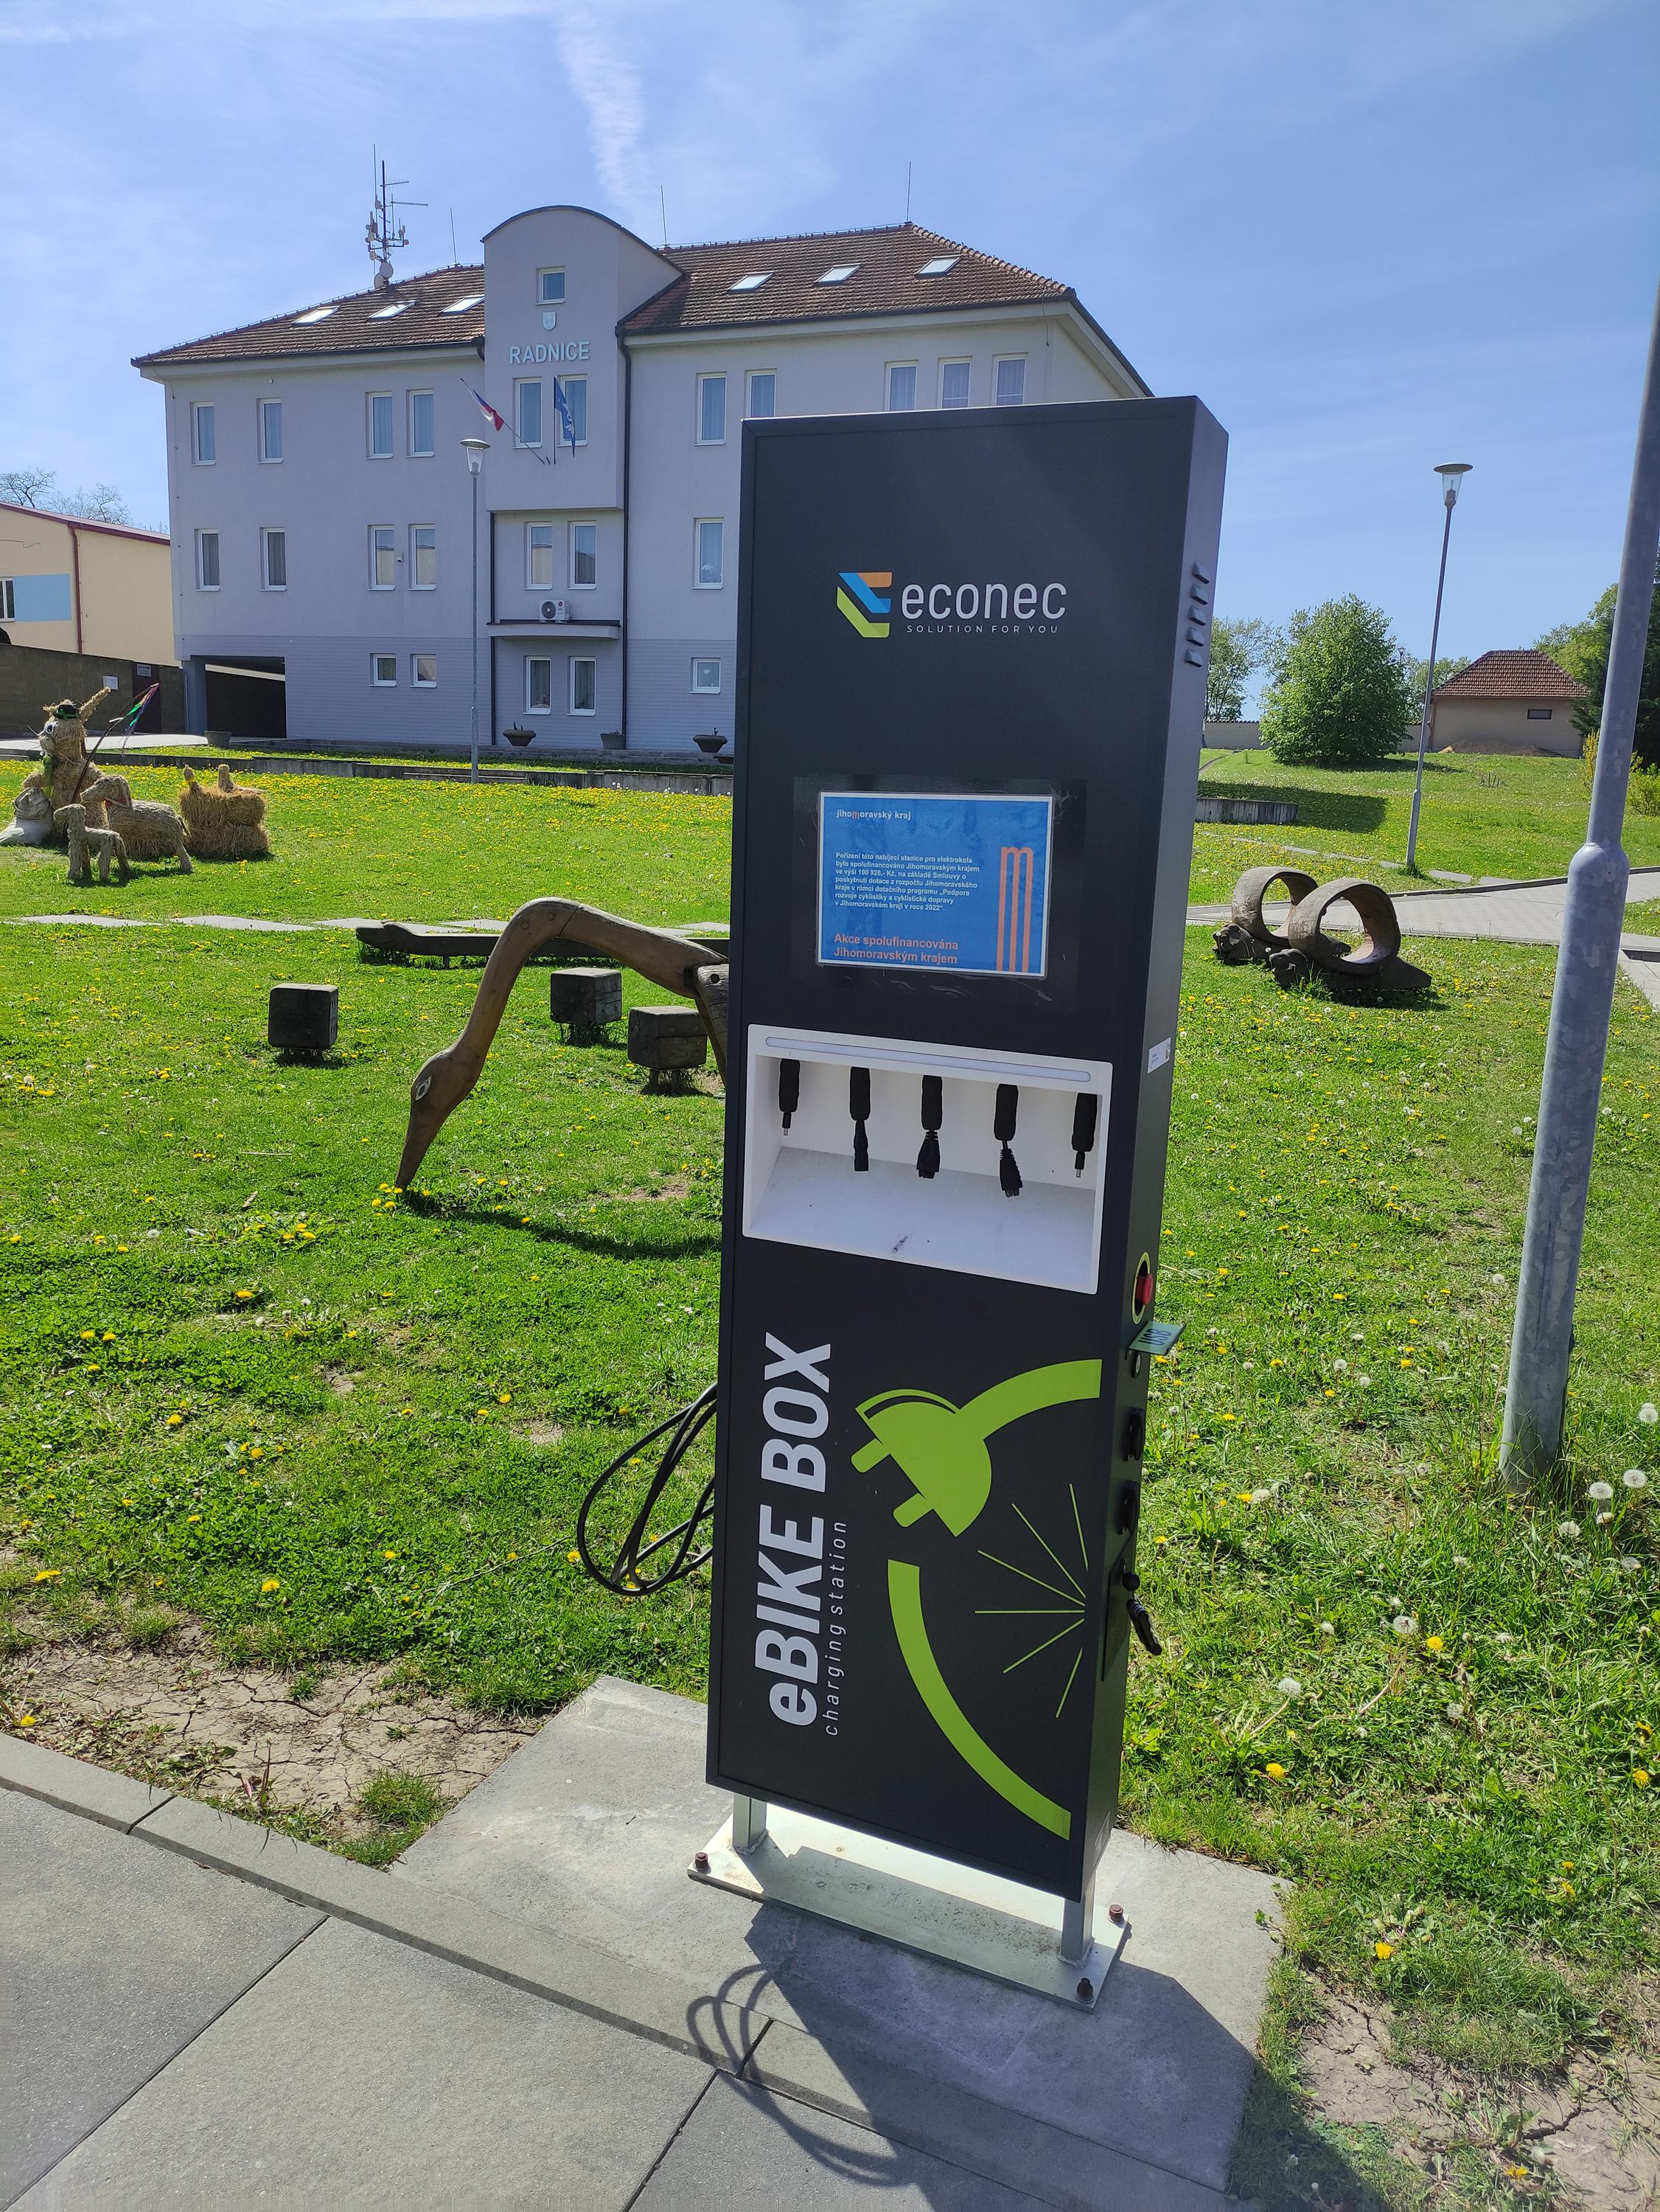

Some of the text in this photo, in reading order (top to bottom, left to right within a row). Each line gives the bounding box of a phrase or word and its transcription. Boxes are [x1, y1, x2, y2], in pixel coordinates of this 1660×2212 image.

[509, 341, 590, 364] RADNICE
[902, 582, 1067, 619] econec
[907, 625, 1059, 634] SOLUTION FOR YOU
[837, 810, 910, 821] jihomoravský kraj
[906, 863, 956, 872] Jihomoravským
[932, 872, 960, 880] Smlouvy
[840, 900, 887, 908] Jihomoravském
[928, 897, 954, 905] dopravy
[834, 933, 958, 950] Akce spolufinancována
[834, 947, 957, 964] Jihomoravským krajem
[1139, 1328, 1171, 1346] USB
[754, 1331, 831, 1727] eBIKE BOX
[822, 1521, 848, 1736] charging station
